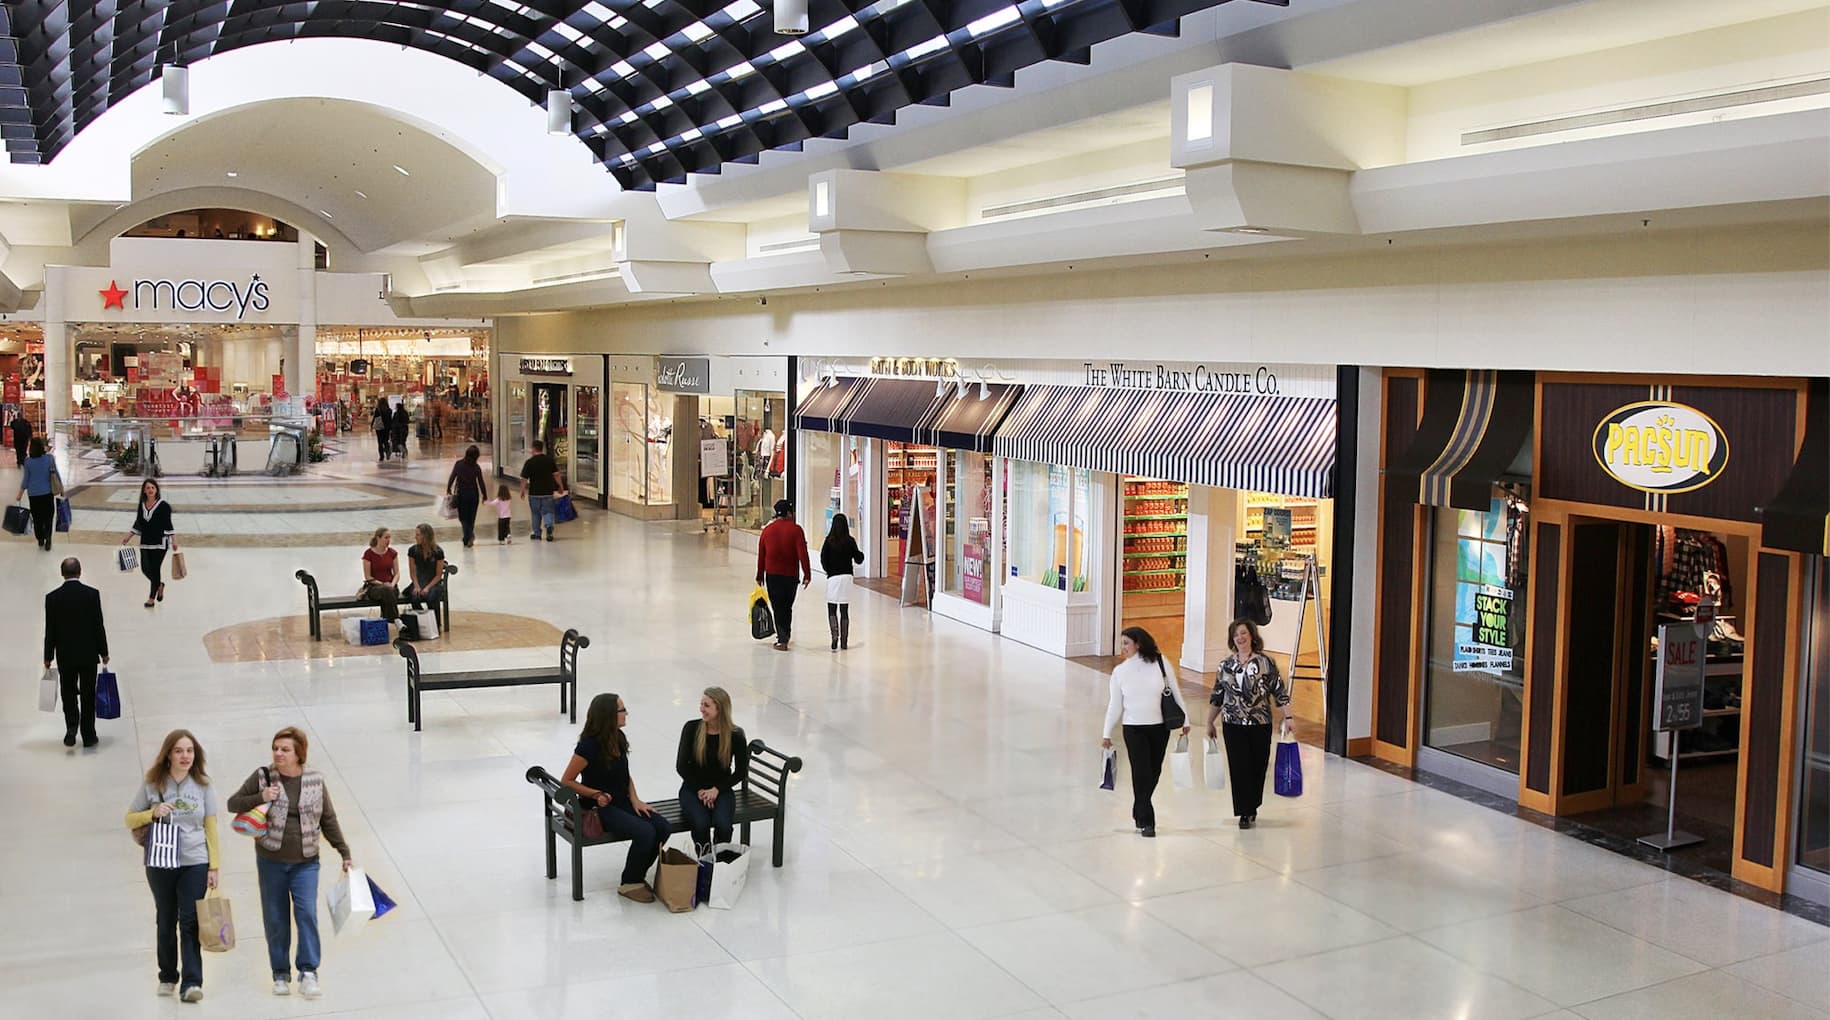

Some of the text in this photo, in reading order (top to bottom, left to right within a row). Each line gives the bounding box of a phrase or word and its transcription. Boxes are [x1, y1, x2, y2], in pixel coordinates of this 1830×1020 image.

[134, 273, 270, 319] macy's
[1476, 595, 1507, 614] STACK
[1480, 611, 1507, 630] YOUR
[1478, 627, 1506, 646] STYLE
[1667, 641, 1697, 665] SALE
